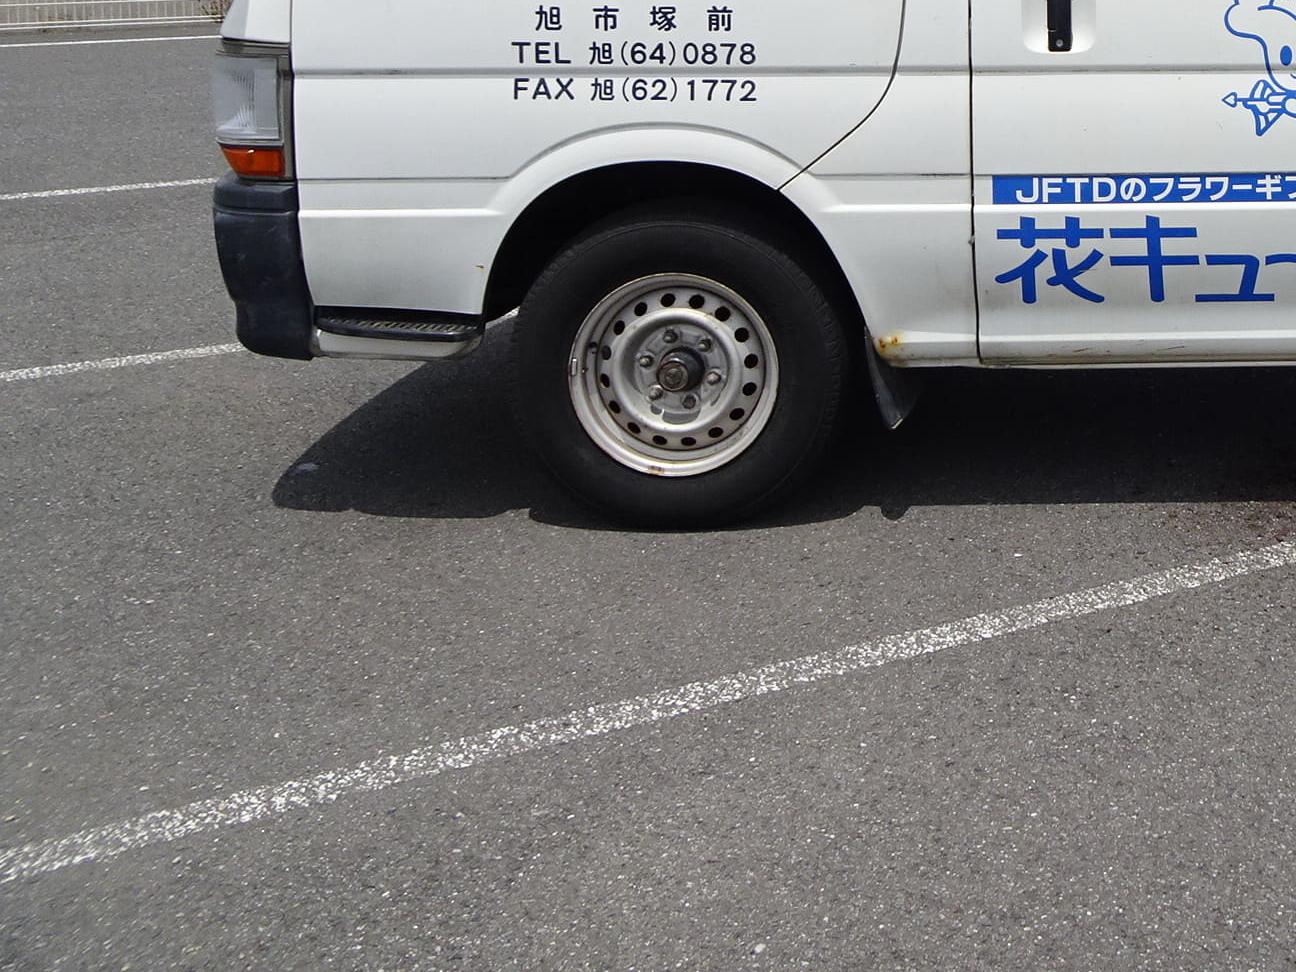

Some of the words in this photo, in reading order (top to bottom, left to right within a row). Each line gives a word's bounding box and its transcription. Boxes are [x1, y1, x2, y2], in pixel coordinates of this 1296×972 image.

[534, 4, 734, 32] 旭市塚前
[510, 41, 572, 65] TEL
[512, 77, 575, 101] FAX
